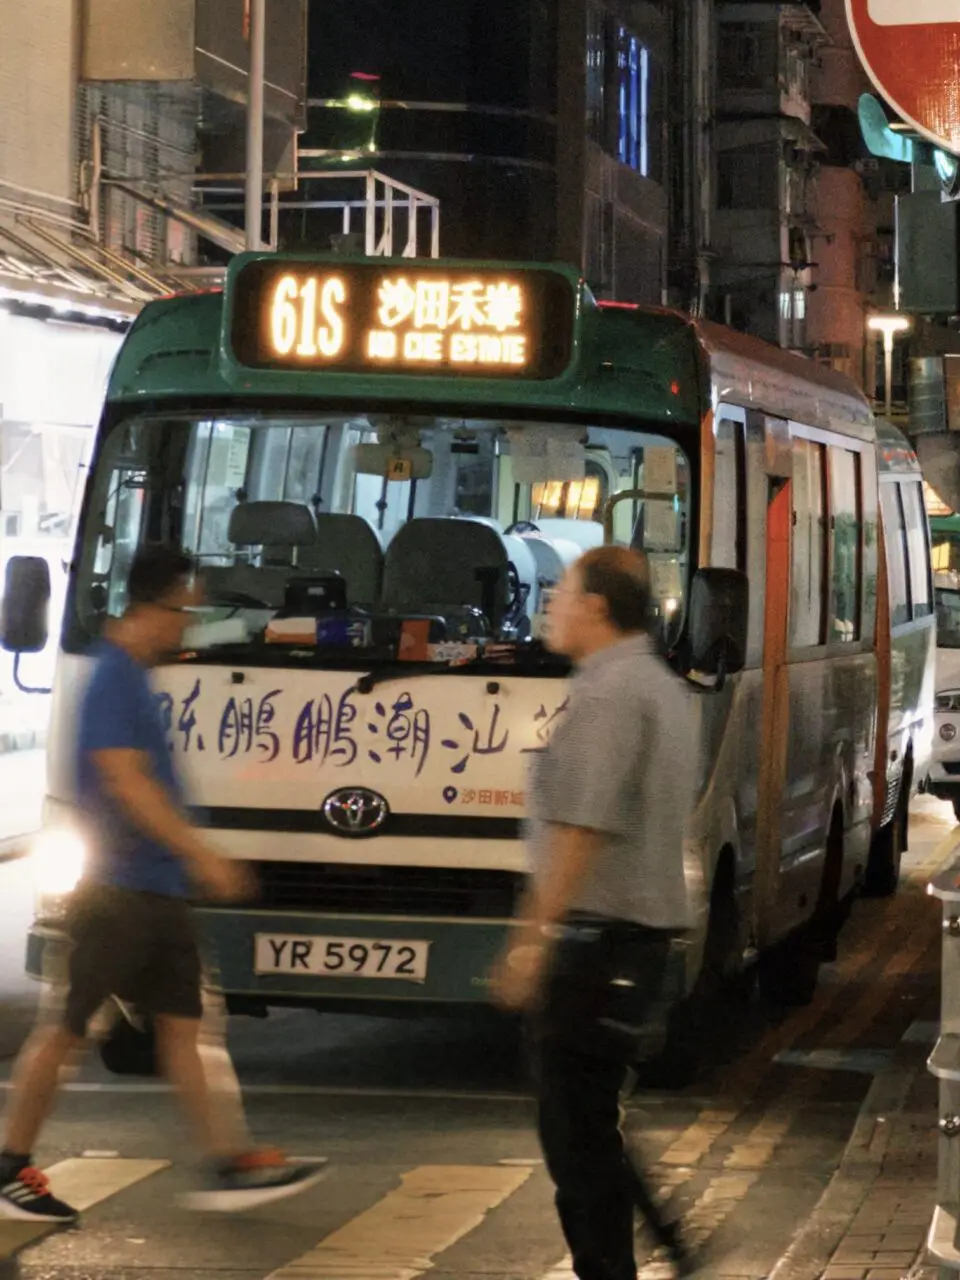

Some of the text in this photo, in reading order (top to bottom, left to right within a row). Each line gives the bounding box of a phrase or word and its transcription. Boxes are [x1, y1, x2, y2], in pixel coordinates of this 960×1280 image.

[271, 275, 346, 357] 61S
[268, 938, 417, 974] YR 5972
